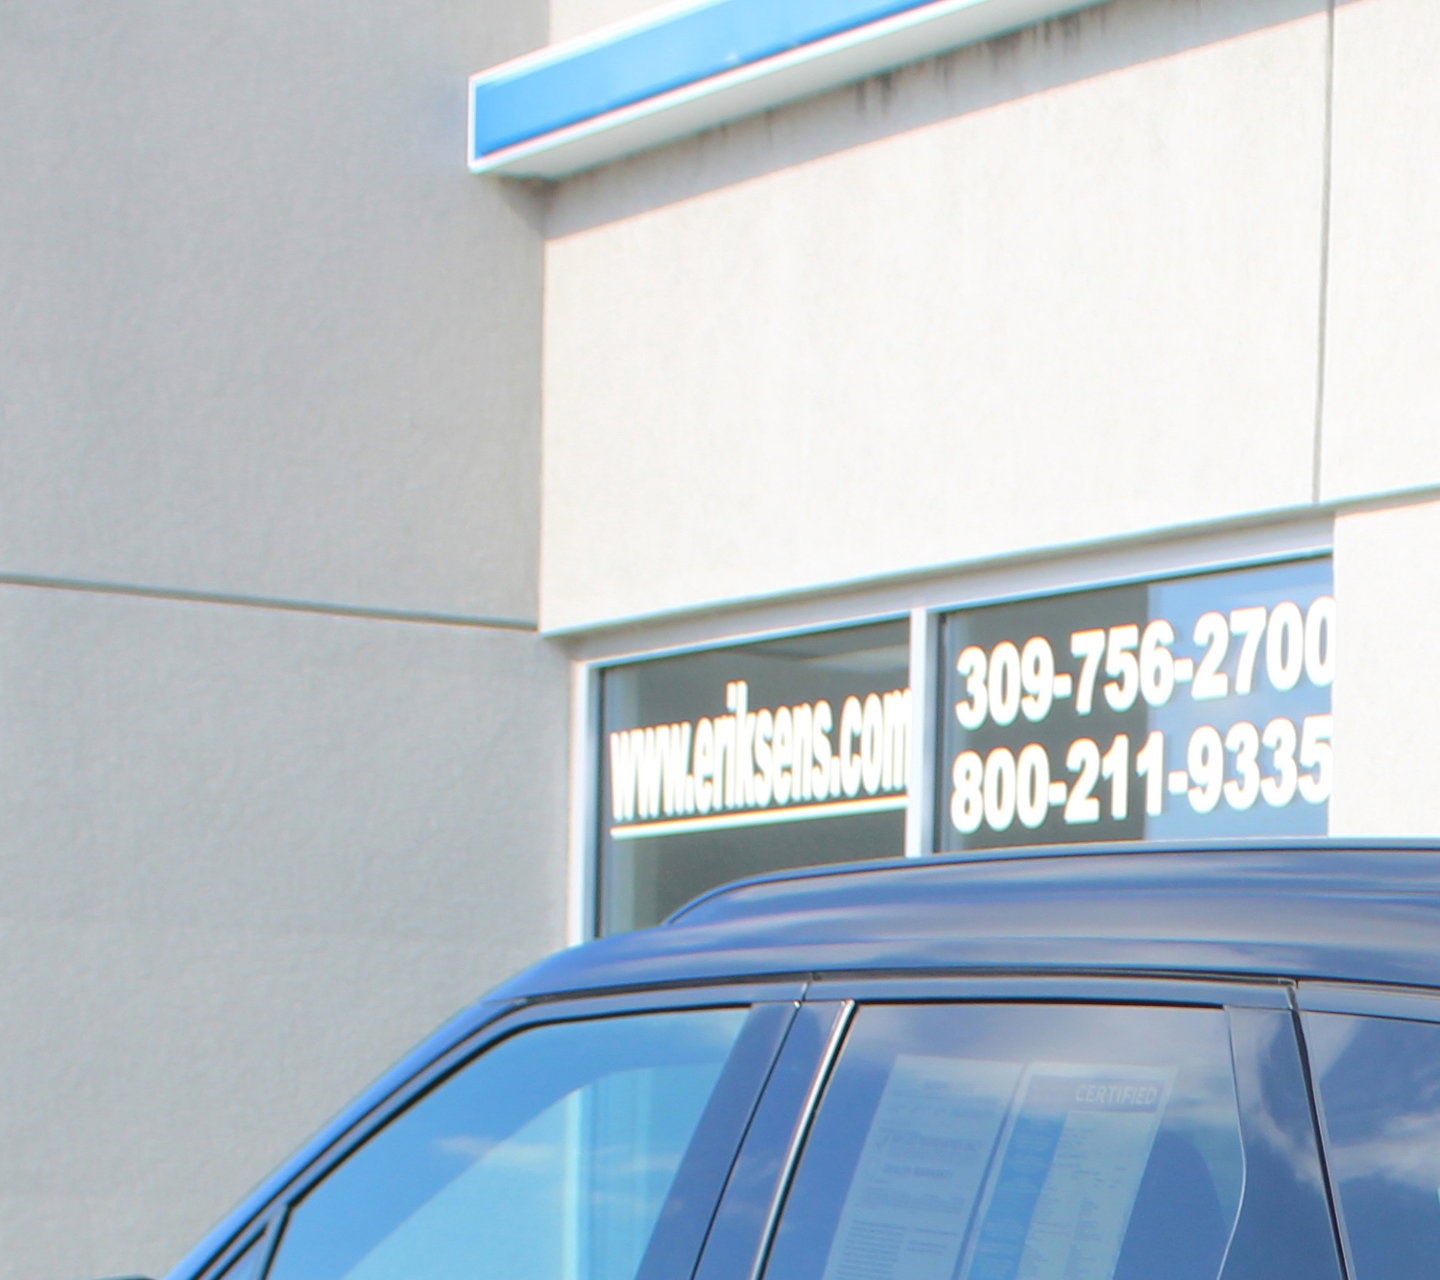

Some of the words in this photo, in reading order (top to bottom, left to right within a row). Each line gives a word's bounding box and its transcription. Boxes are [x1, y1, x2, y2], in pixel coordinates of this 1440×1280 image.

[955, 596, 1336, 730] 309-756-2700
[610, 680, 913, 821] www.eriksens.com
[949, 713, 1334, 834] 800-211-9335
